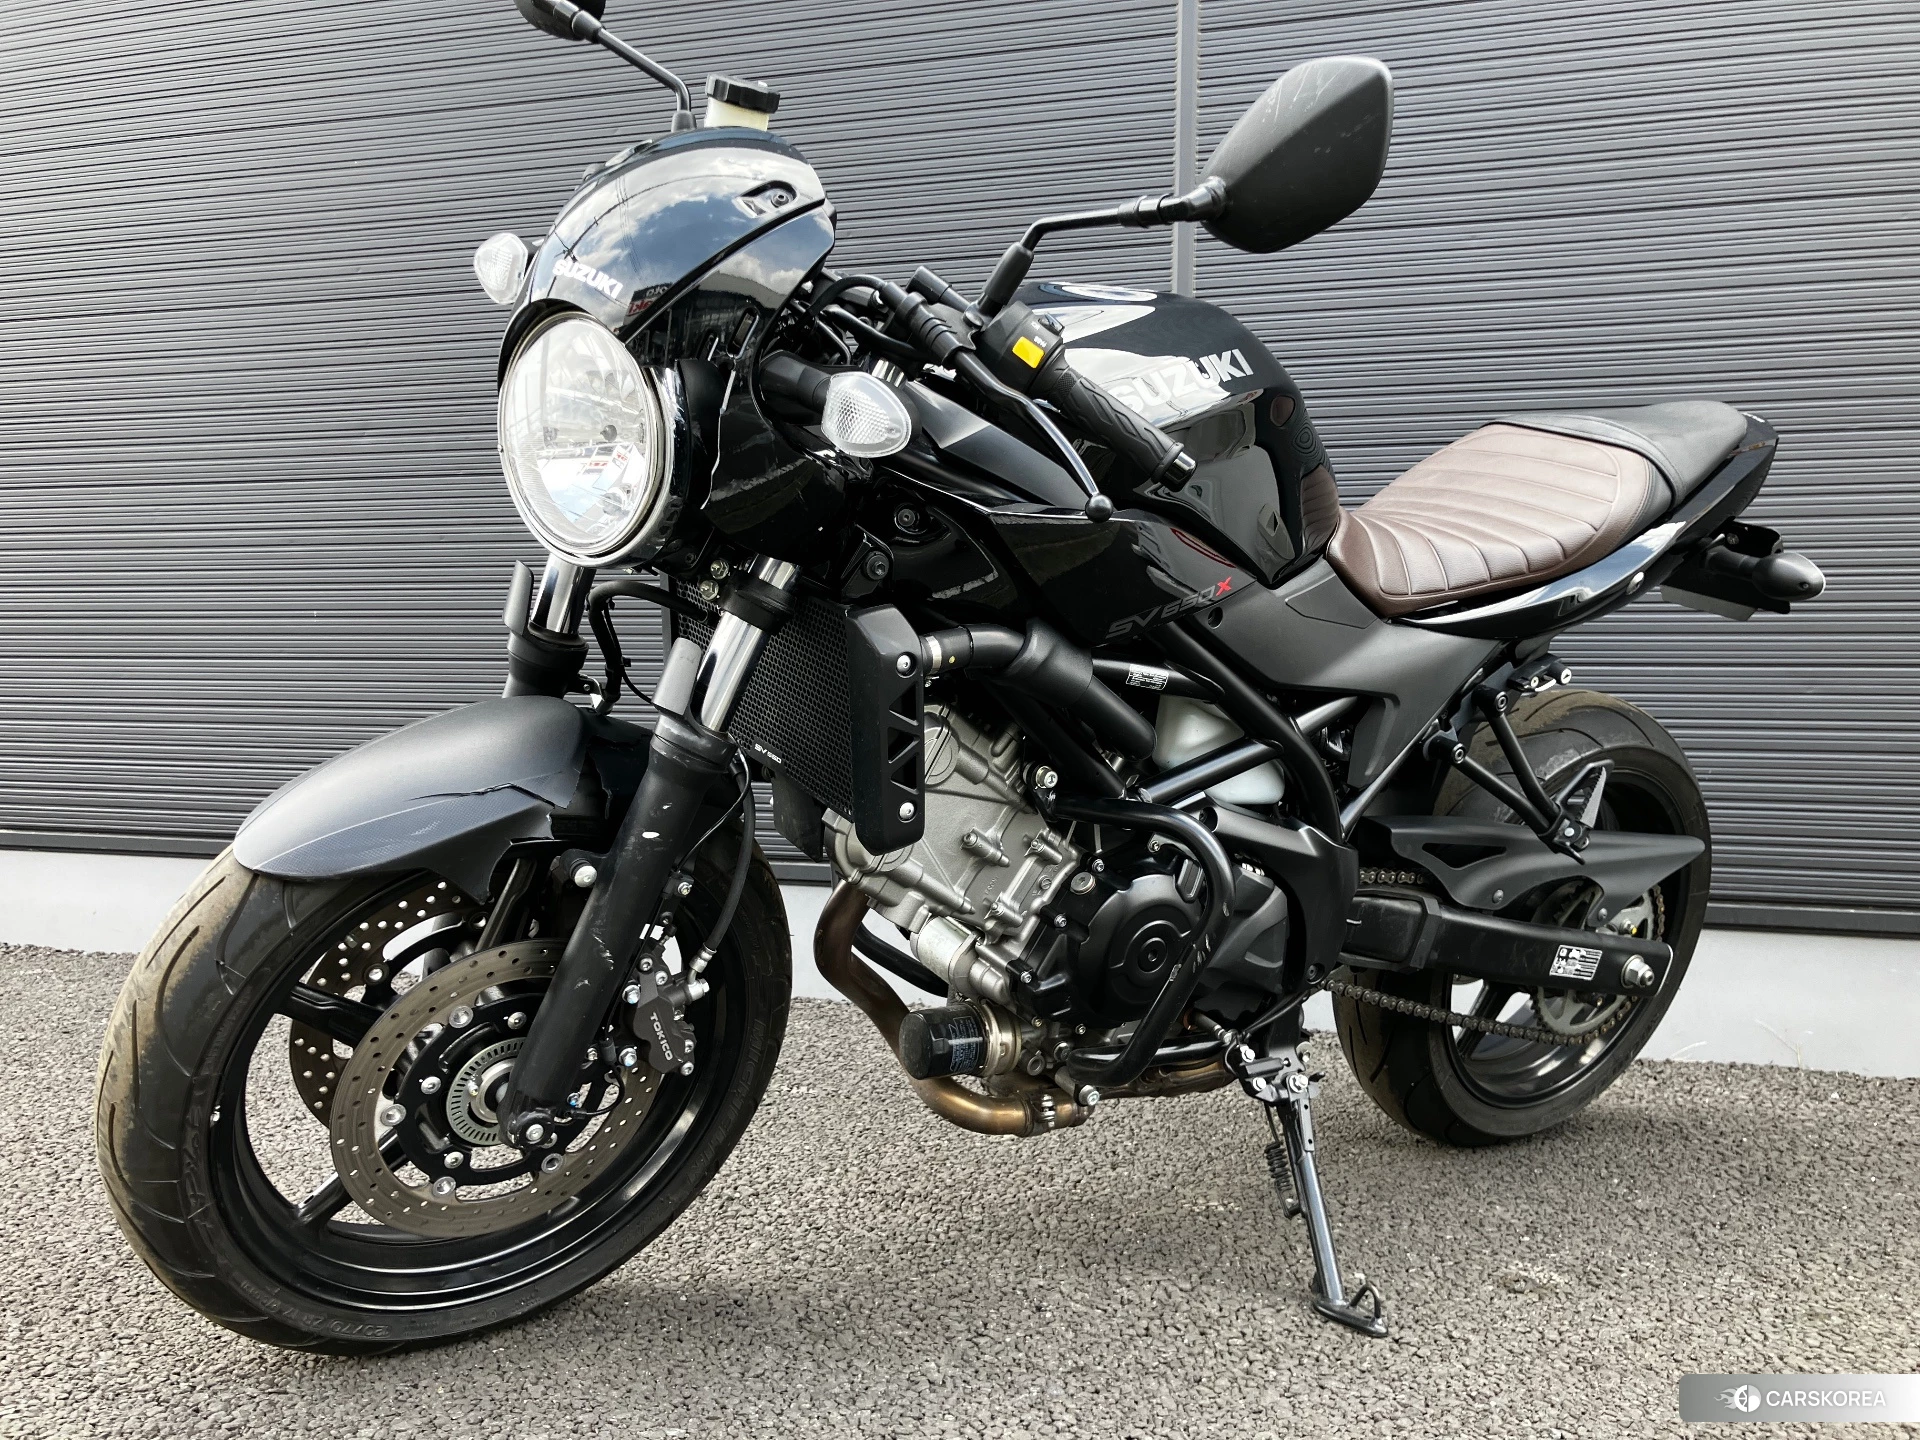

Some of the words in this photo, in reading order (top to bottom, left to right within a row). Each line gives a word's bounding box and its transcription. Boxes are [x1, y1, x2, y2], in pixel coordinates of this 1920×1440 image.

[552, 259, 624, 300] SUZUKI
[1107, 348, 1254, 415] SUZUKI
[650, 1012, 673, 1061] TOKICO
